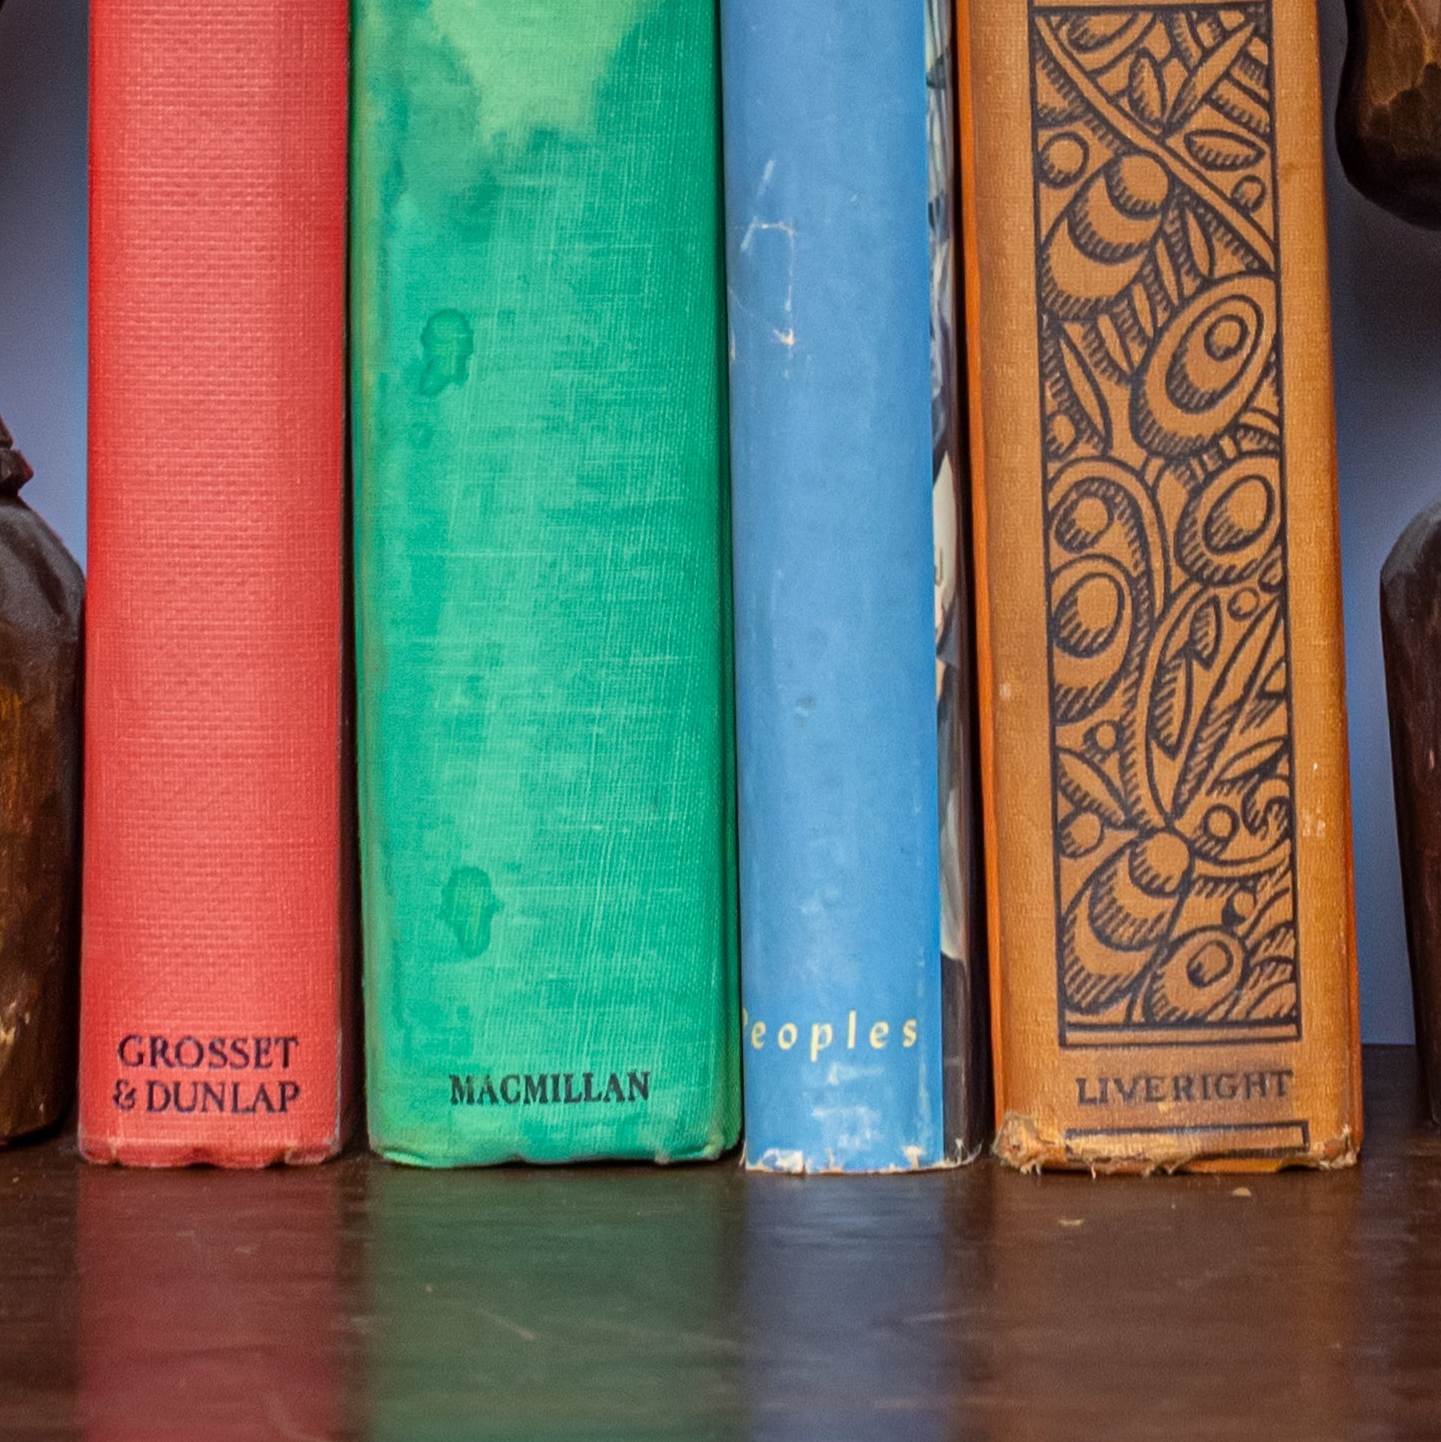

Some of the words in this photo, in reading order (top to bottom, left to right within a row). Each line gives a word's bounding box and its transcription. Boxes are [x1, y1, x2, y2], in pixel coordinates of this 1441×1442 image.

[118, 1035, 299, 1069] GROSSET
[112, 1079, 136, 1111] &
[146, 1081, 301, 1114] DUNLAP
[449, 1071, 651, 1105] MACMILLAN
[1076, 1069, 1293, 1105] LIVERIGHT
